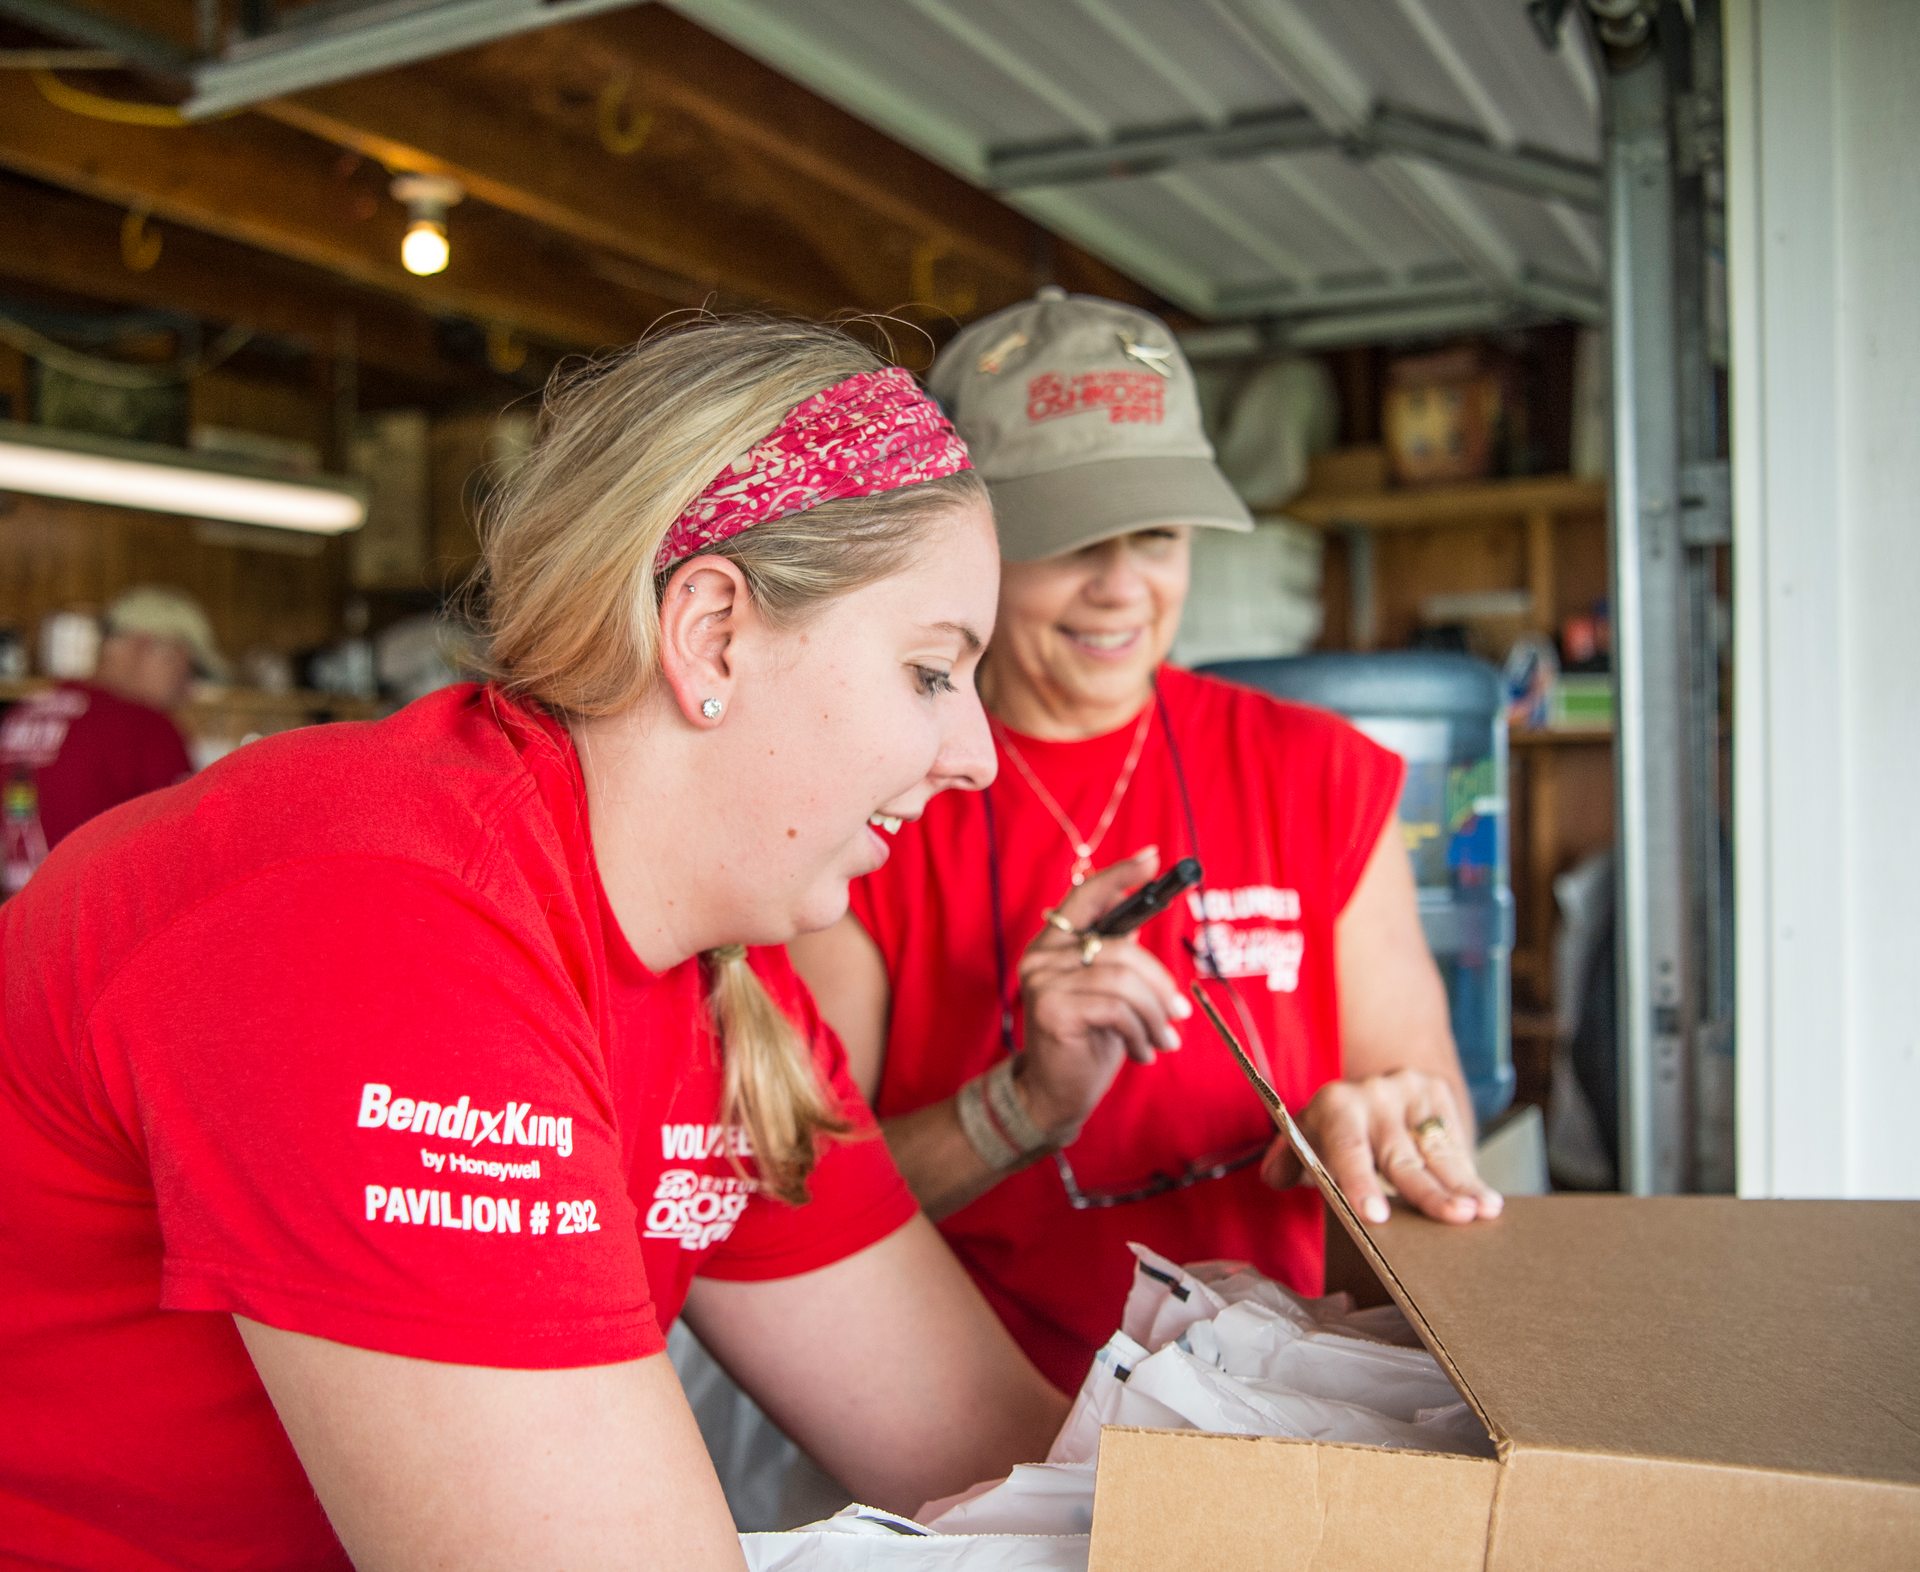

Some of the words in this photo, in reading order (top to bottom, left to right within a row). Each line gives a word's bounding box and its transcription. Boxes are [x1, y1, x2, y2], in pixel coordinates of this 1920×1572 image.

[357, 1083, 573, 1157] BendixKing
[421, 1148, 446, 1173] by
[449, 1153, 541, 1182] Honeywell
[365, 1185, 521, 1233] PAVILION
[530, 1202, 551, 1235] #
[556, 1200, 601, 1234] 292
